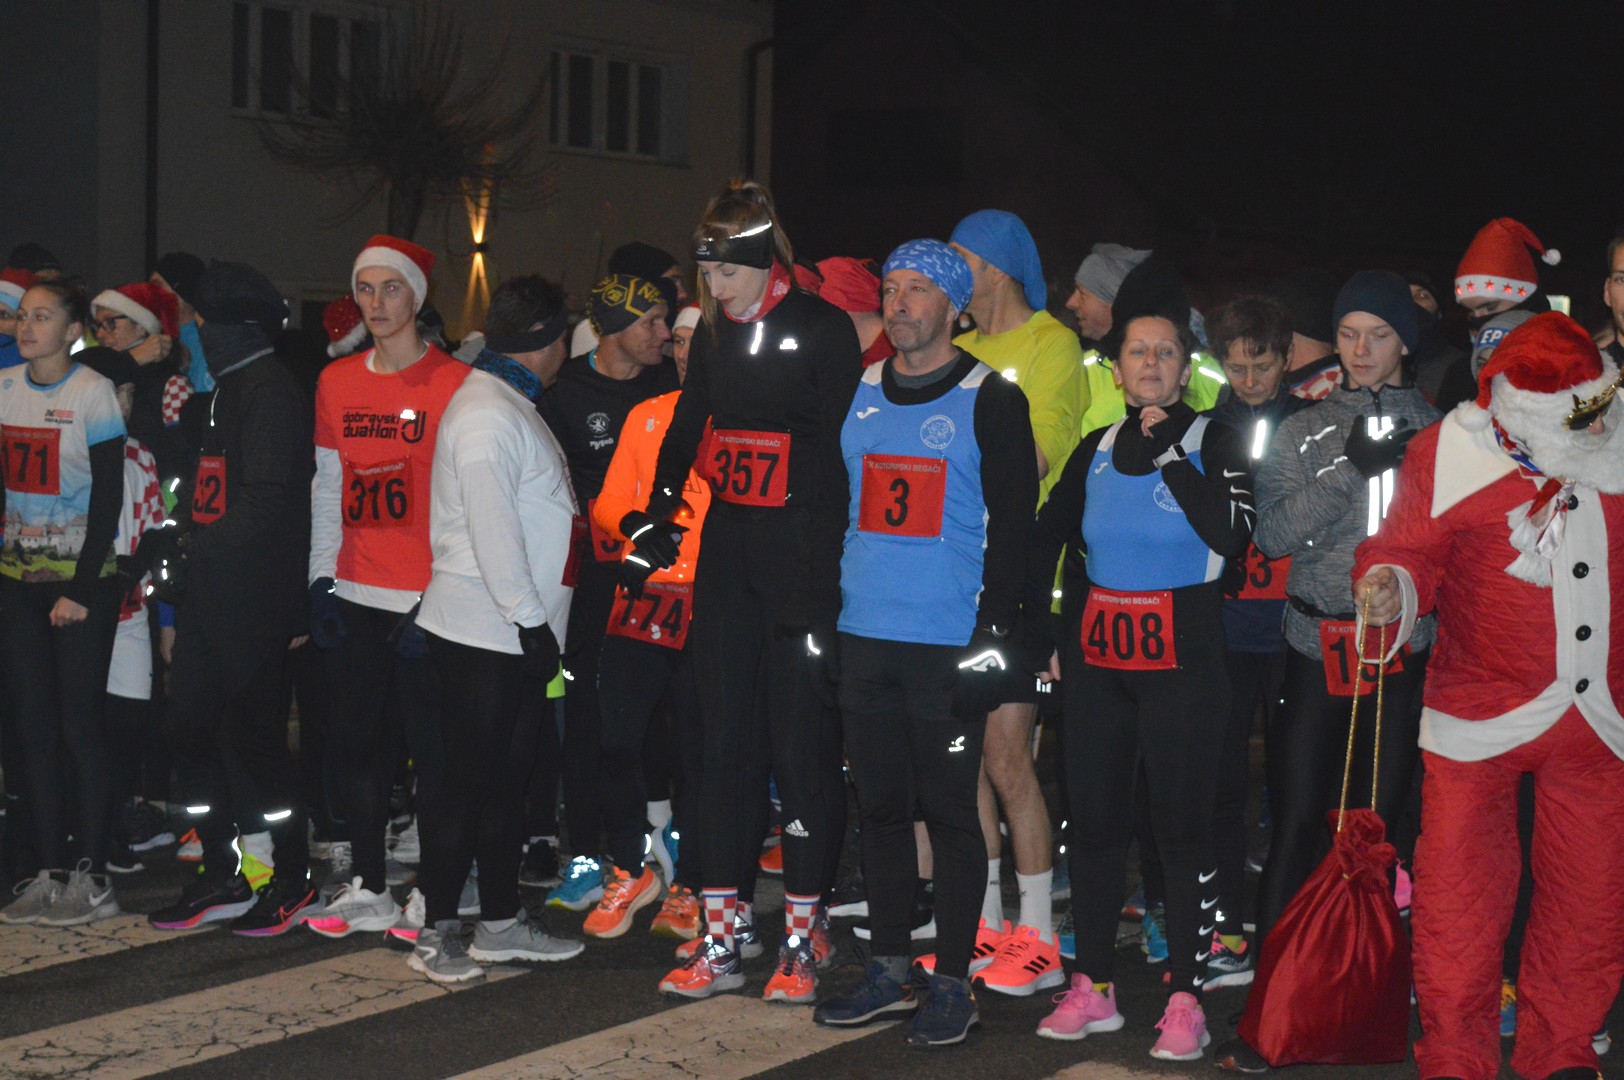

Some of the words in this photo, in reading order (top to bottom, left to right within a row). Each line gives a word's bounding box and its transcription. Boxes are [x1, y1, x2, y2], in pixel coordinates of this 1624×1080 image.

[1480, 329, 1511, 343] EP
[756, 438, 781, 447] BEGAČI
[711, 449, 779, 497] 357
[912, 464, 941, 473] BEGAČI
[348, 478, 407, 521] 316
[885, 477, 909, 527] 3
[1132, 596, 1160, 605] BEGAČI
[1087, 609, 1165, 661] 408
